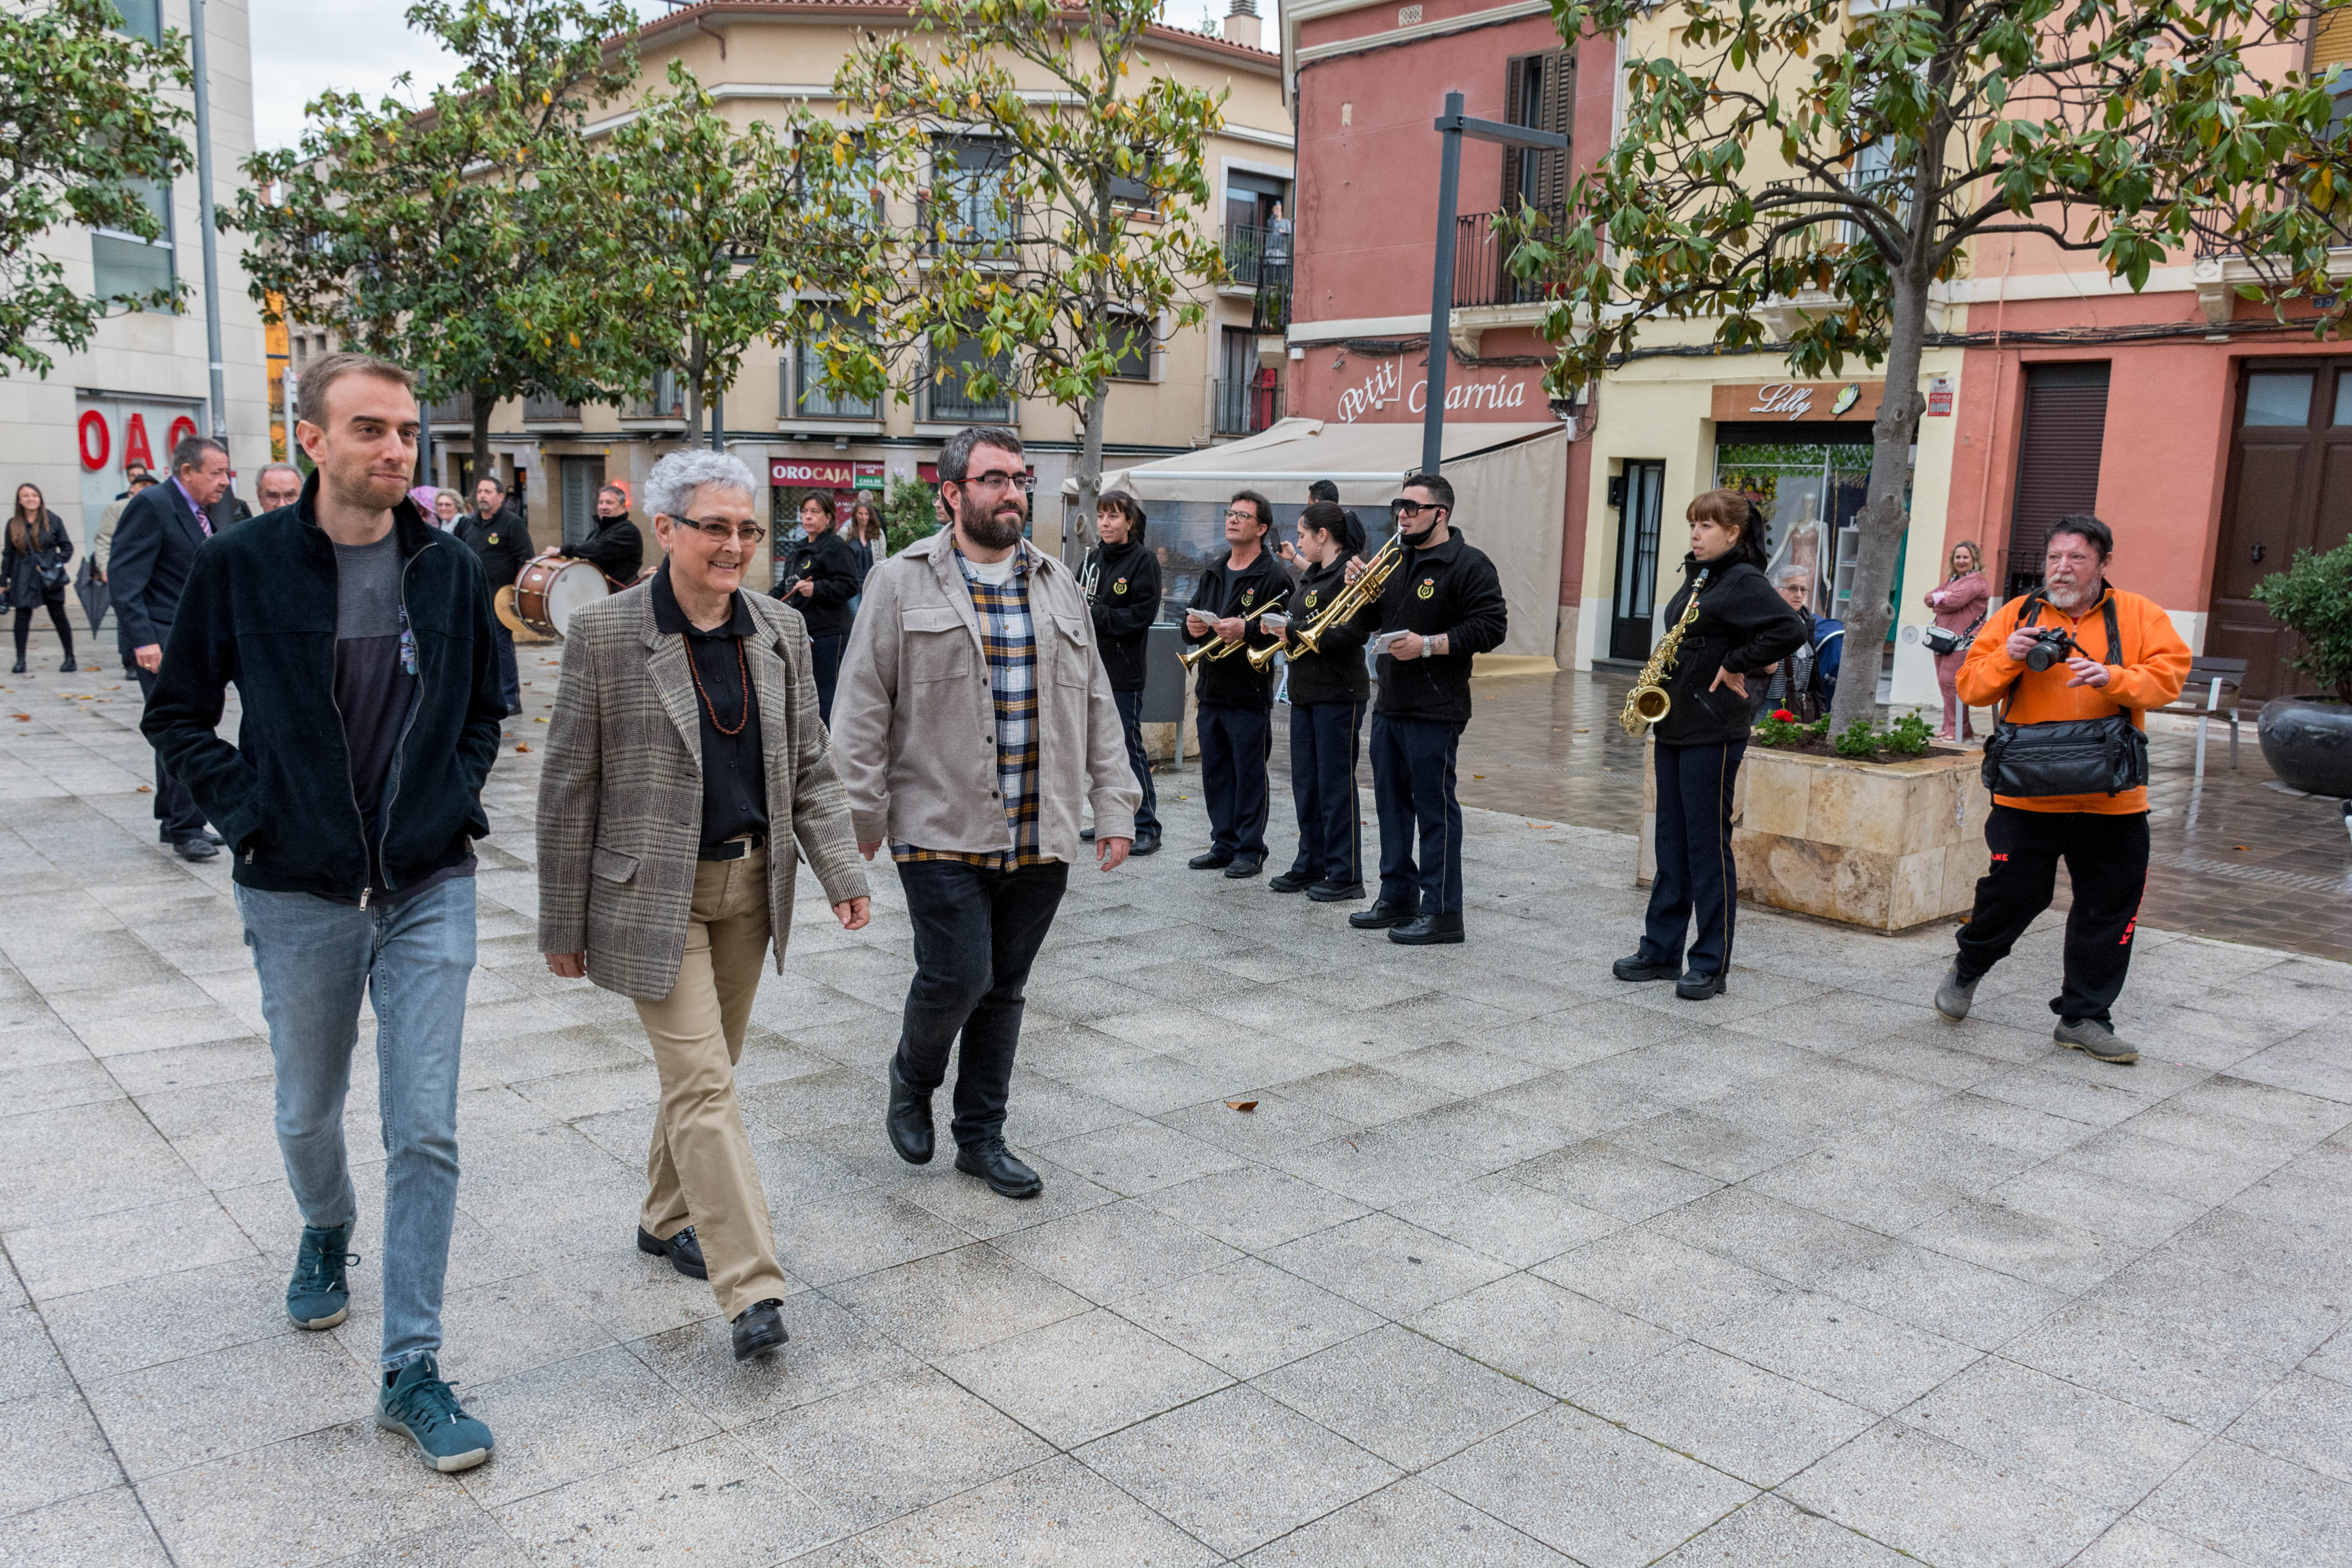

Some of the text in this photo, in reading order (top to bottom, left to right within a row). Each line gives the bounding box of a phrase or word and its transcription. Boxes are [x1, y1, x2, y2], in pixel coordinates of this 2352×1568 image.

[1338, 360, 1525, 424] Petit Carrúa
[1749, 383, 1813, 421] Lilly
[772, 465, 851, 483] OROCAJA
